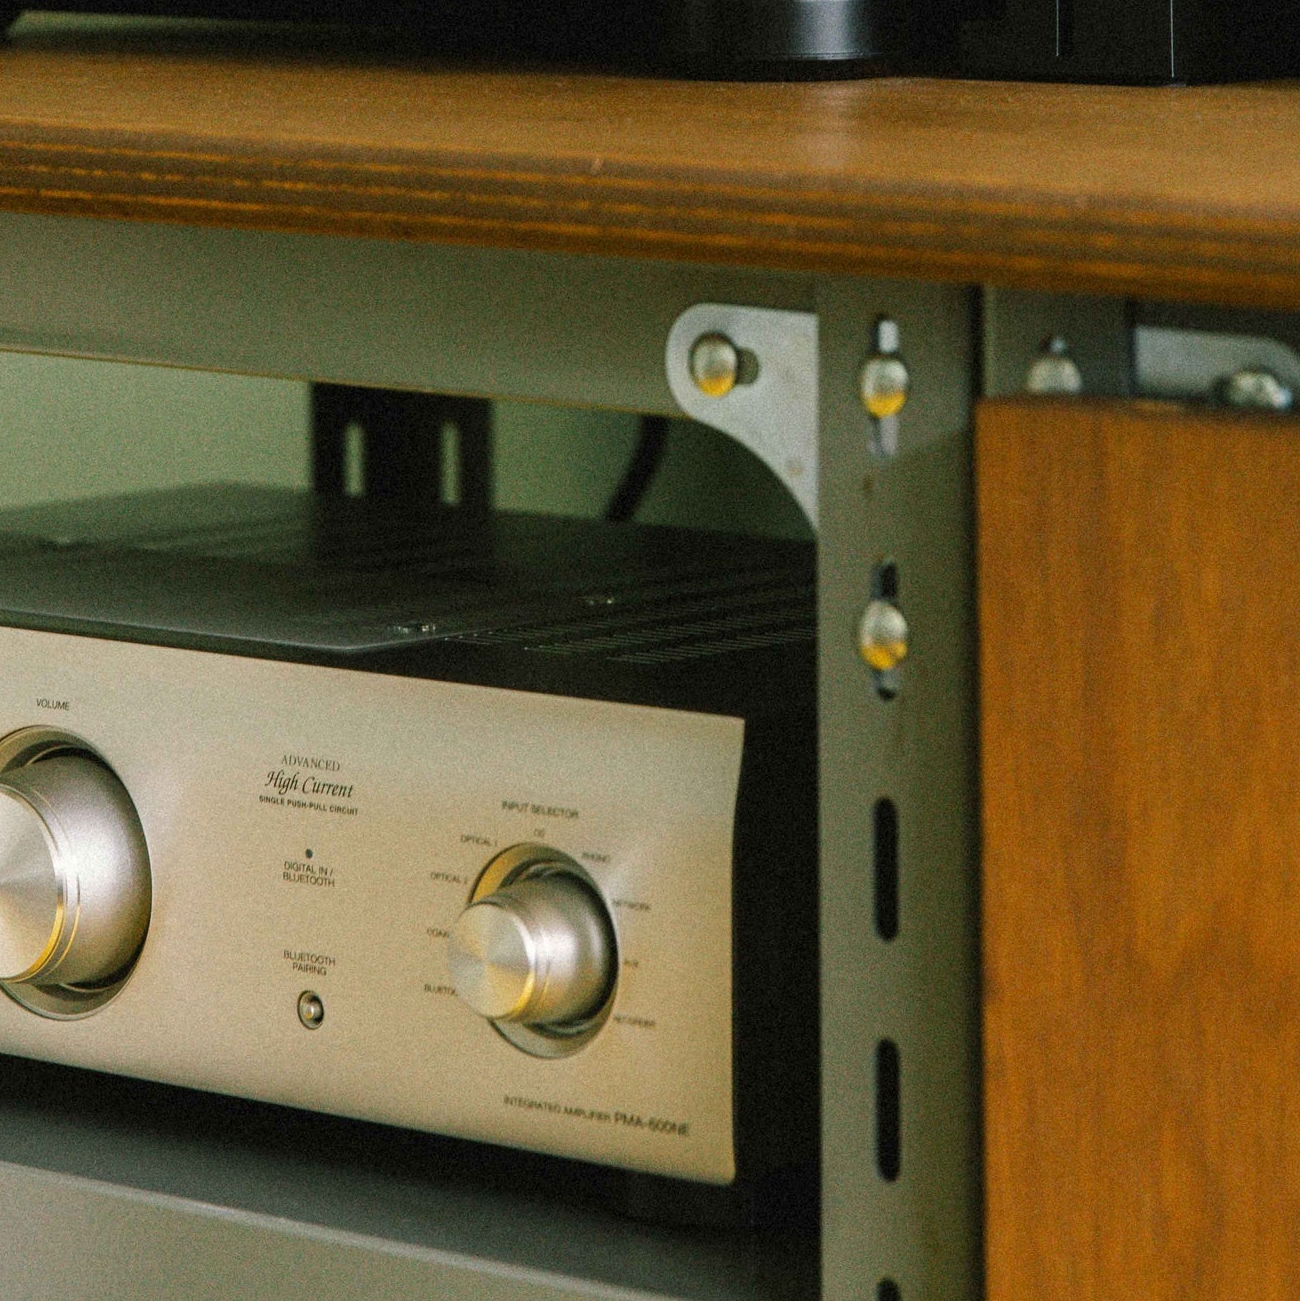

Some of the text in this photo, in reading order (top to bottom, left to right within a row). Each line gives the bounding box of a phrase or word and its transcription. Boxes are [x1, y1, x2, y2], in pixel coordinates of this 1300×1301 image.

[36, 698, 70, 711] VOLUME
[281, 754, 341, 772] ADVANCED
[264, 769, 354, 798] High Current
[259, 795, 359, 816] SINGLE PUSH-PULL CIRCUIT
[283, 860, 316, 875] DIGITAL
[282, 870, 335, 888] BLUETOOTH
[283, 949, 336, 967] BLUETOOTH
[292, 962, 327, 977] PAIRING
